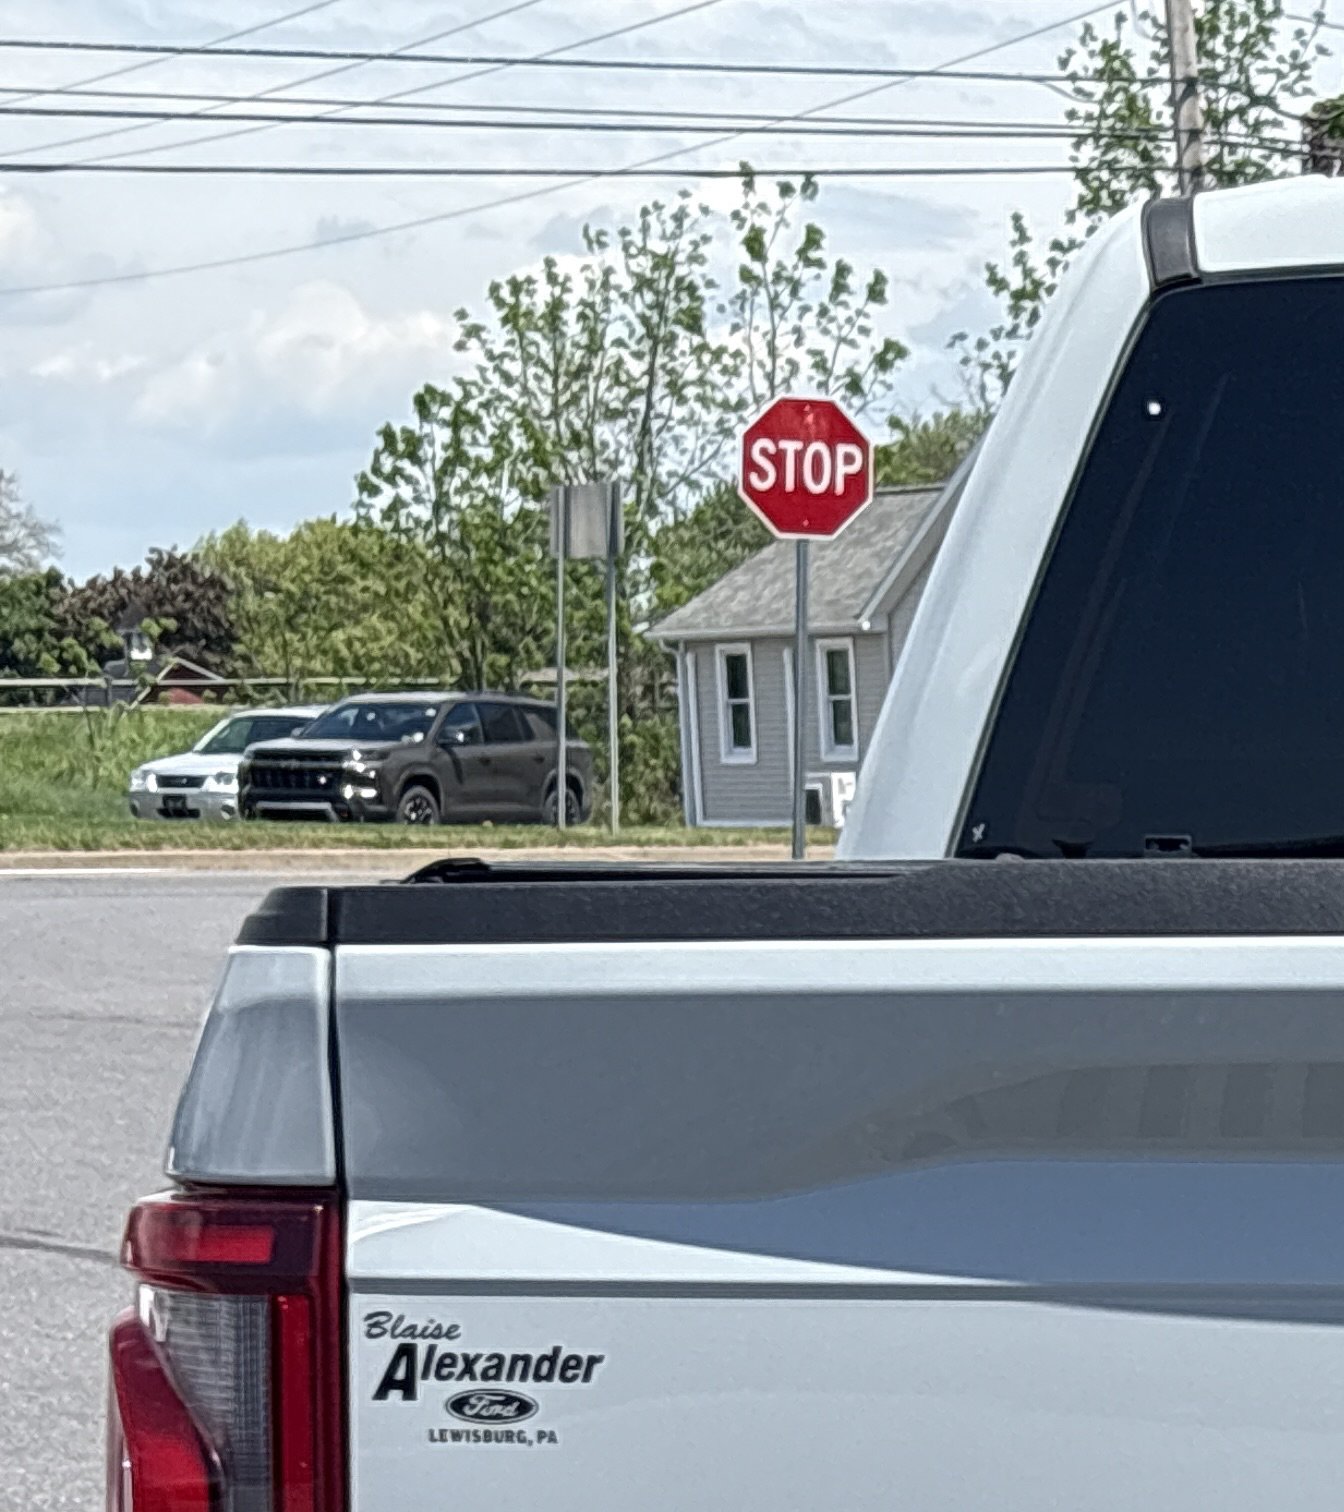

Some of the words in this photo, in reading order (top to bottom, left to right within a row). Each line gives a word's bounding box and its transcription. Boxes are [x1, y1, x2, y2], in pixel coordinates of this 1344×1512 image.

[750, 438, 863, 496] STOP
[364, 1311, 461, 1340] Blaise
[372, 1343, 604, 1401] Alexander
[463, 1395, 518, 1417] Ford
[428, 1428, 533, 1445] LEWISBURG,
[537, 1430, 557, 1443] PA
